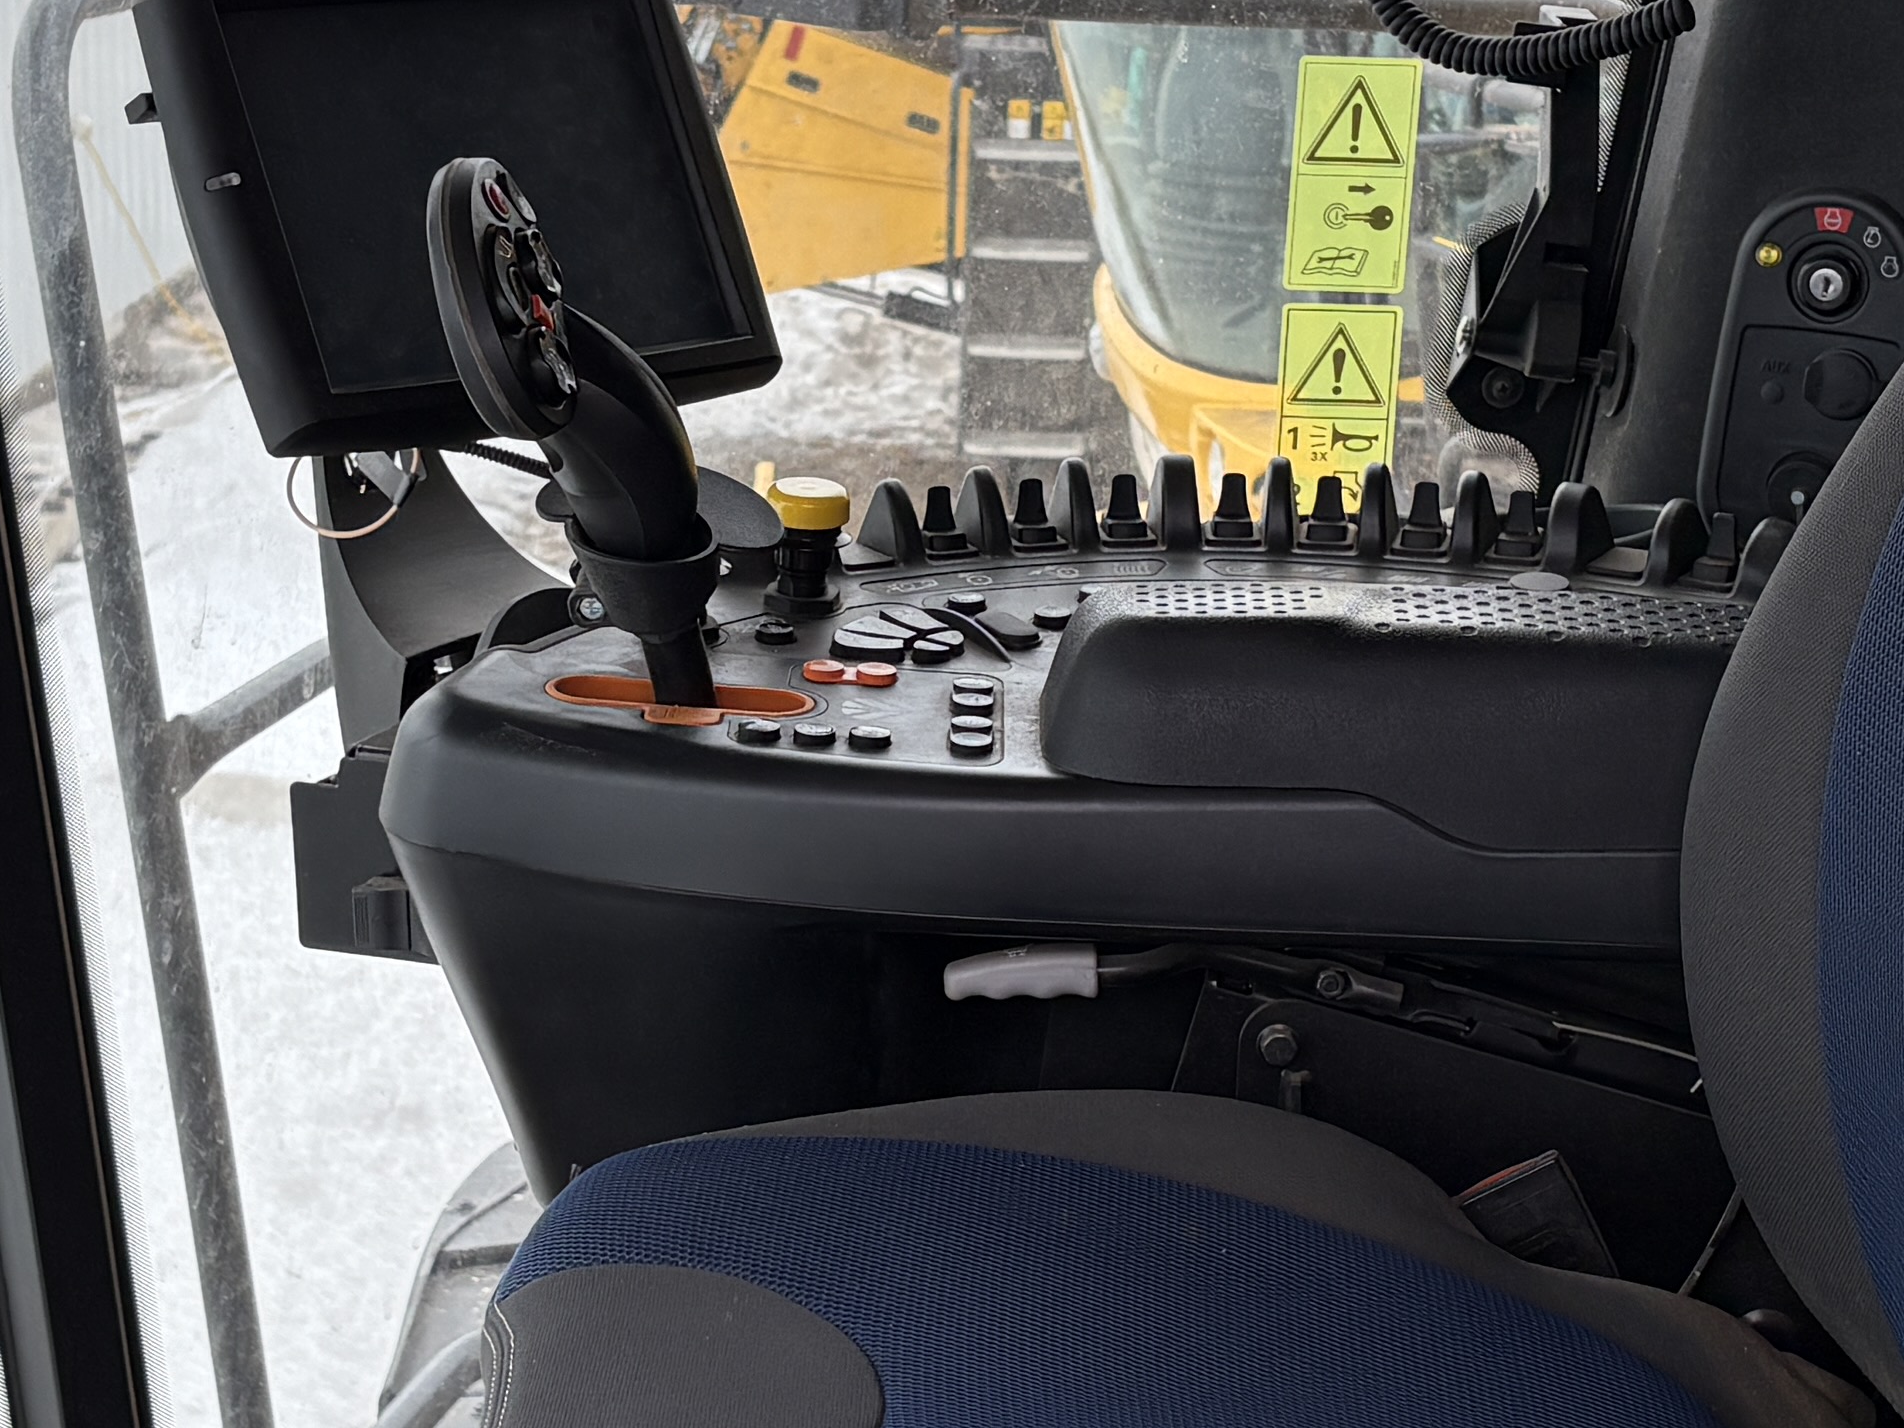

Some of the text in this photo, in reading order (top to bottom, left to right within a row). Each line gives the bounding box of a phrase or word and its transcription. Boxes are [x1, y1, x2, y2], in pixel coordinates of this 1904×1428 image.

[1761, 359, 1791, 374] AUX
[1287, 426, 1299, 450] 1
[1310, 451, 1328, 462] 3X
